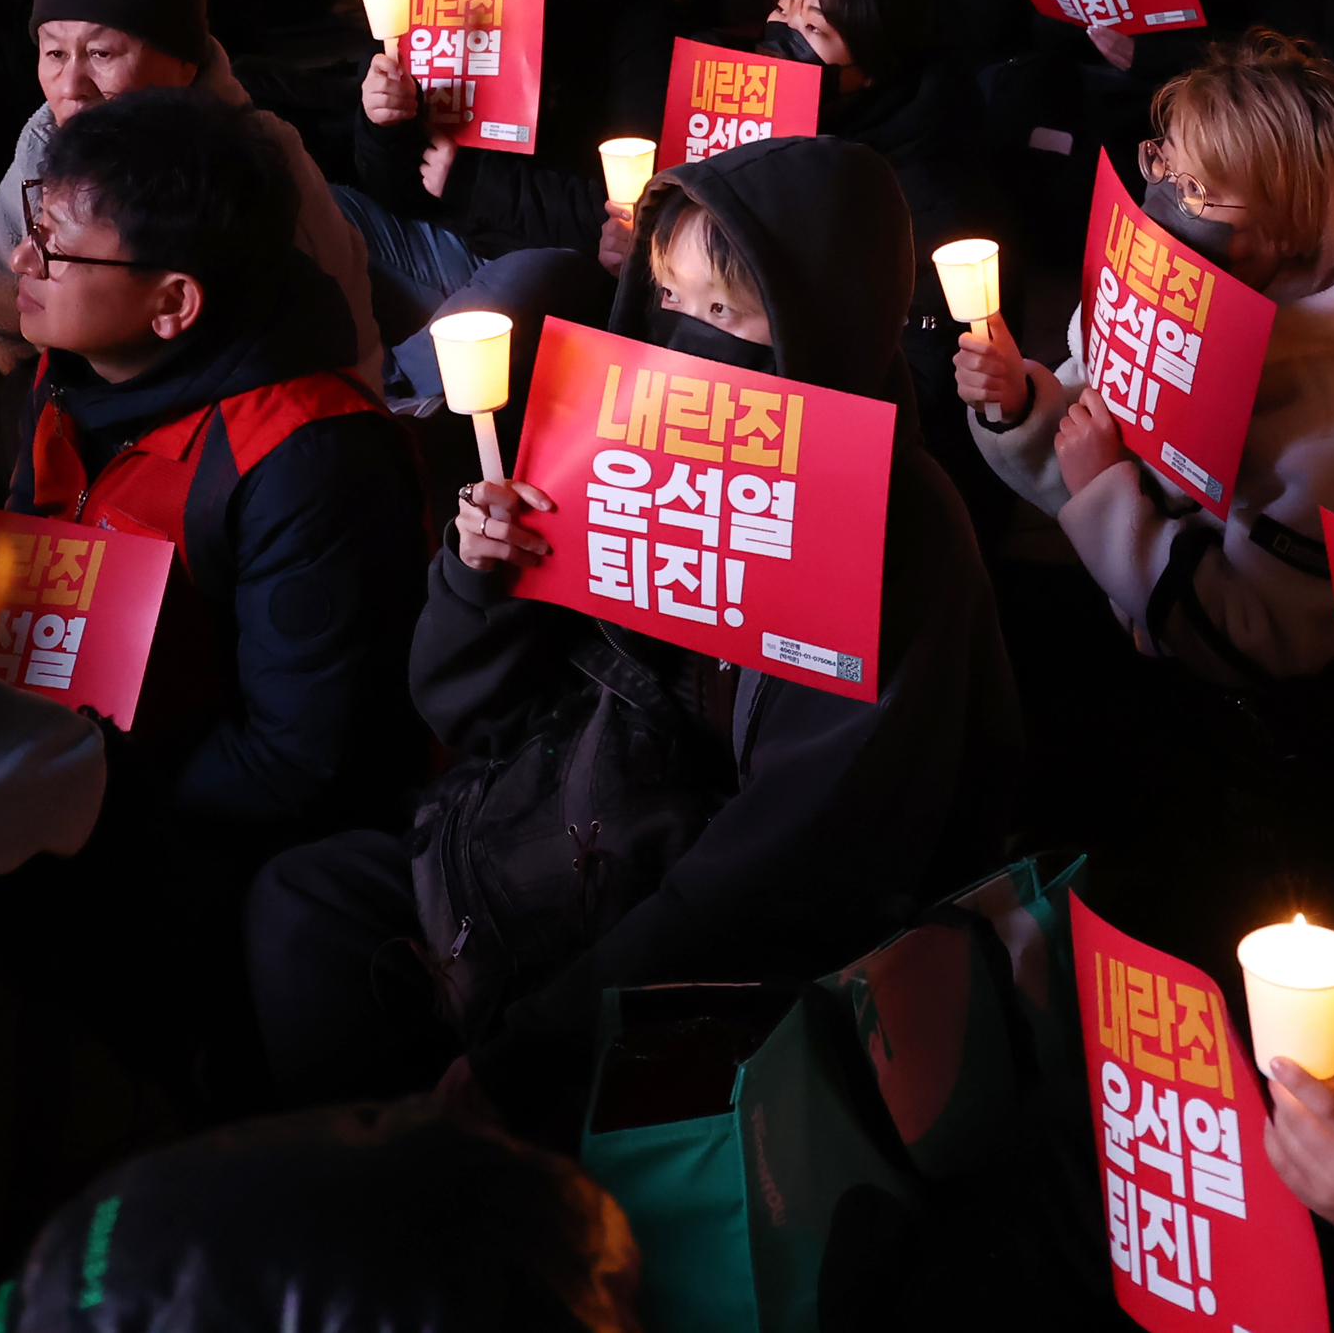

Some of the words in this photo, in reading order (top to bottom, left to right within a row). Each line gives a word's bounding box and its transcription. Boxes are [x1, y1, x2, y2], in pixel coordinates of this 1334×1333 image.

[410, 29, 502, 77] 윤석열
[690, 59, 778, 119] 내란죄
[1105, 202, 1216, 333] 내란죄
[1087, 321, 1161, 432] 퇴진!
[1094, 265, 1202, 396] 윤석열
[595, 363, 805, 476] 내란죄
[586, 449, 797, 561] 윤석열
[586, 530, 746, 629] 퇴진!
[1095, 951, 1236, 1100] 내란죄
[1101, 1060, 1247, 1220] 윤석열
[1106, 1167, 1217, 1316] 퇴진!
